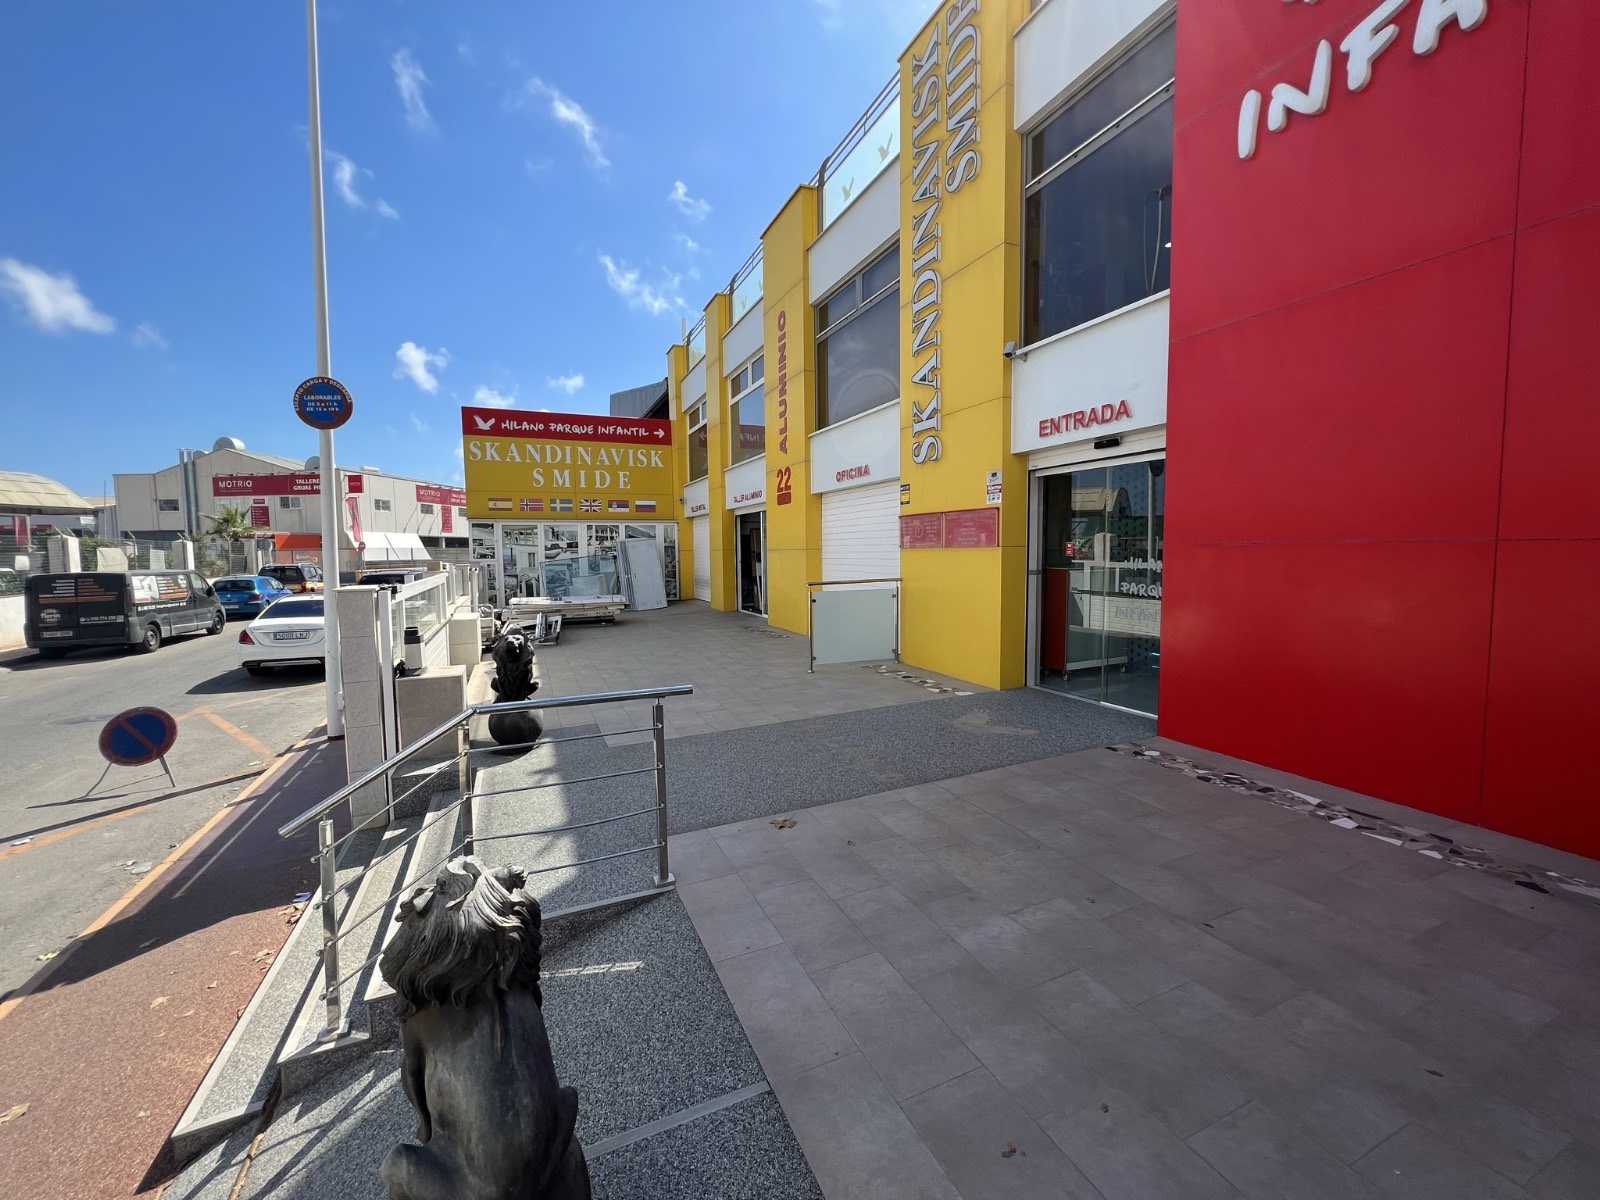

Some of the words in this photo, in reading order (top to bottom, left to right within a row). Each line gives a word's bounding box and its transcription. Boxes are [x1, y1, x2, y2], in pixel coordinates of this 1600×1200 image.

[1237, 0, 1488, 160] INFA
[912, 22, 942, 464] SKANDINAVISK
[303, 379, 322, 388] CARGA
[329, 380, 352, 403] DESCARGA
[778, 309, 788, 455] ALUMINIO
[501, 419, 544, 431] MILANO
[549, 422, 594, 435] PARQUE
[598, 425, 650, 437] INFANTIL
[1039, 399, 1132, 438] ENTRADA
[469, 441, 664, 468] SKANDINAVISK
[218, 479, 253, 488] MOTRIO
[532, 468, 631, 489] SMIDE
[777, 466, 791, 493] 22
[836, 464, 871, 483] OFICINA
[733, 494, 745, 504] TALLER
[745, 490, 763, 502] ALUMINIO
